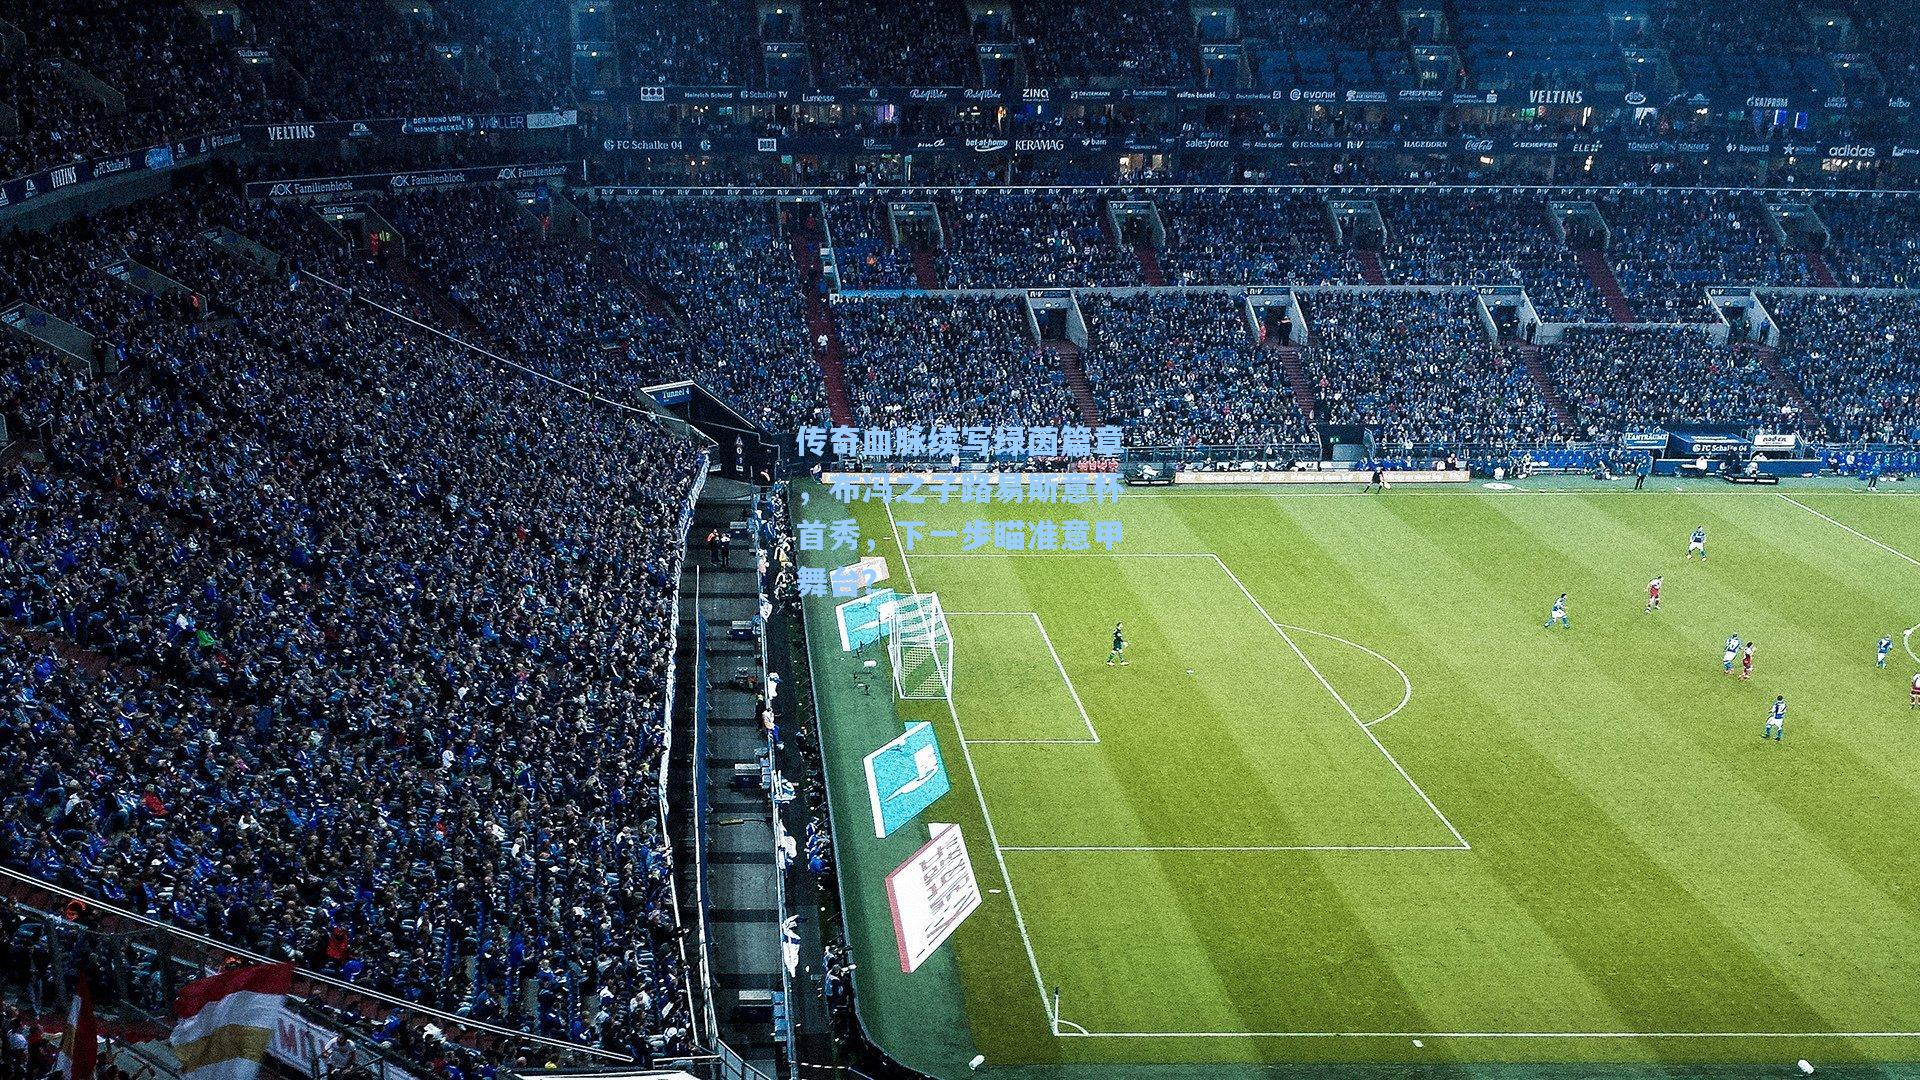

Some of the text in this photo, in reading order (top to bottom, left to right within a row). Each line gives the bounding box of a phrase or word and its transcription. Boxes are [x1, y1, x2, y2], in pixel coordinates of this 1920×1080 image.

[778, 91, 788, 99] TV
[1022, 89, 1049, 98] ZINQ
[1529, 90, 1583, 104] VELTINS
[268, 125, 316, 140] VELTINS
[617, 139, 683, 150] FC Schalke 04
[1015, 139, 1064, 151] KERAMAG
[1186, 138, 1229, 150] salesforce
[1828, 145, 1876, 157] adidas
[51, 166, 77, 189] VELTINS
[497, 166, 568, 180] AOK Familienblock
[390, 173, 465, 187] AOK Familienblock
[268, 181, 353, 197] AOK Familienblock
[662, 389, 684, 400] Tunnel
